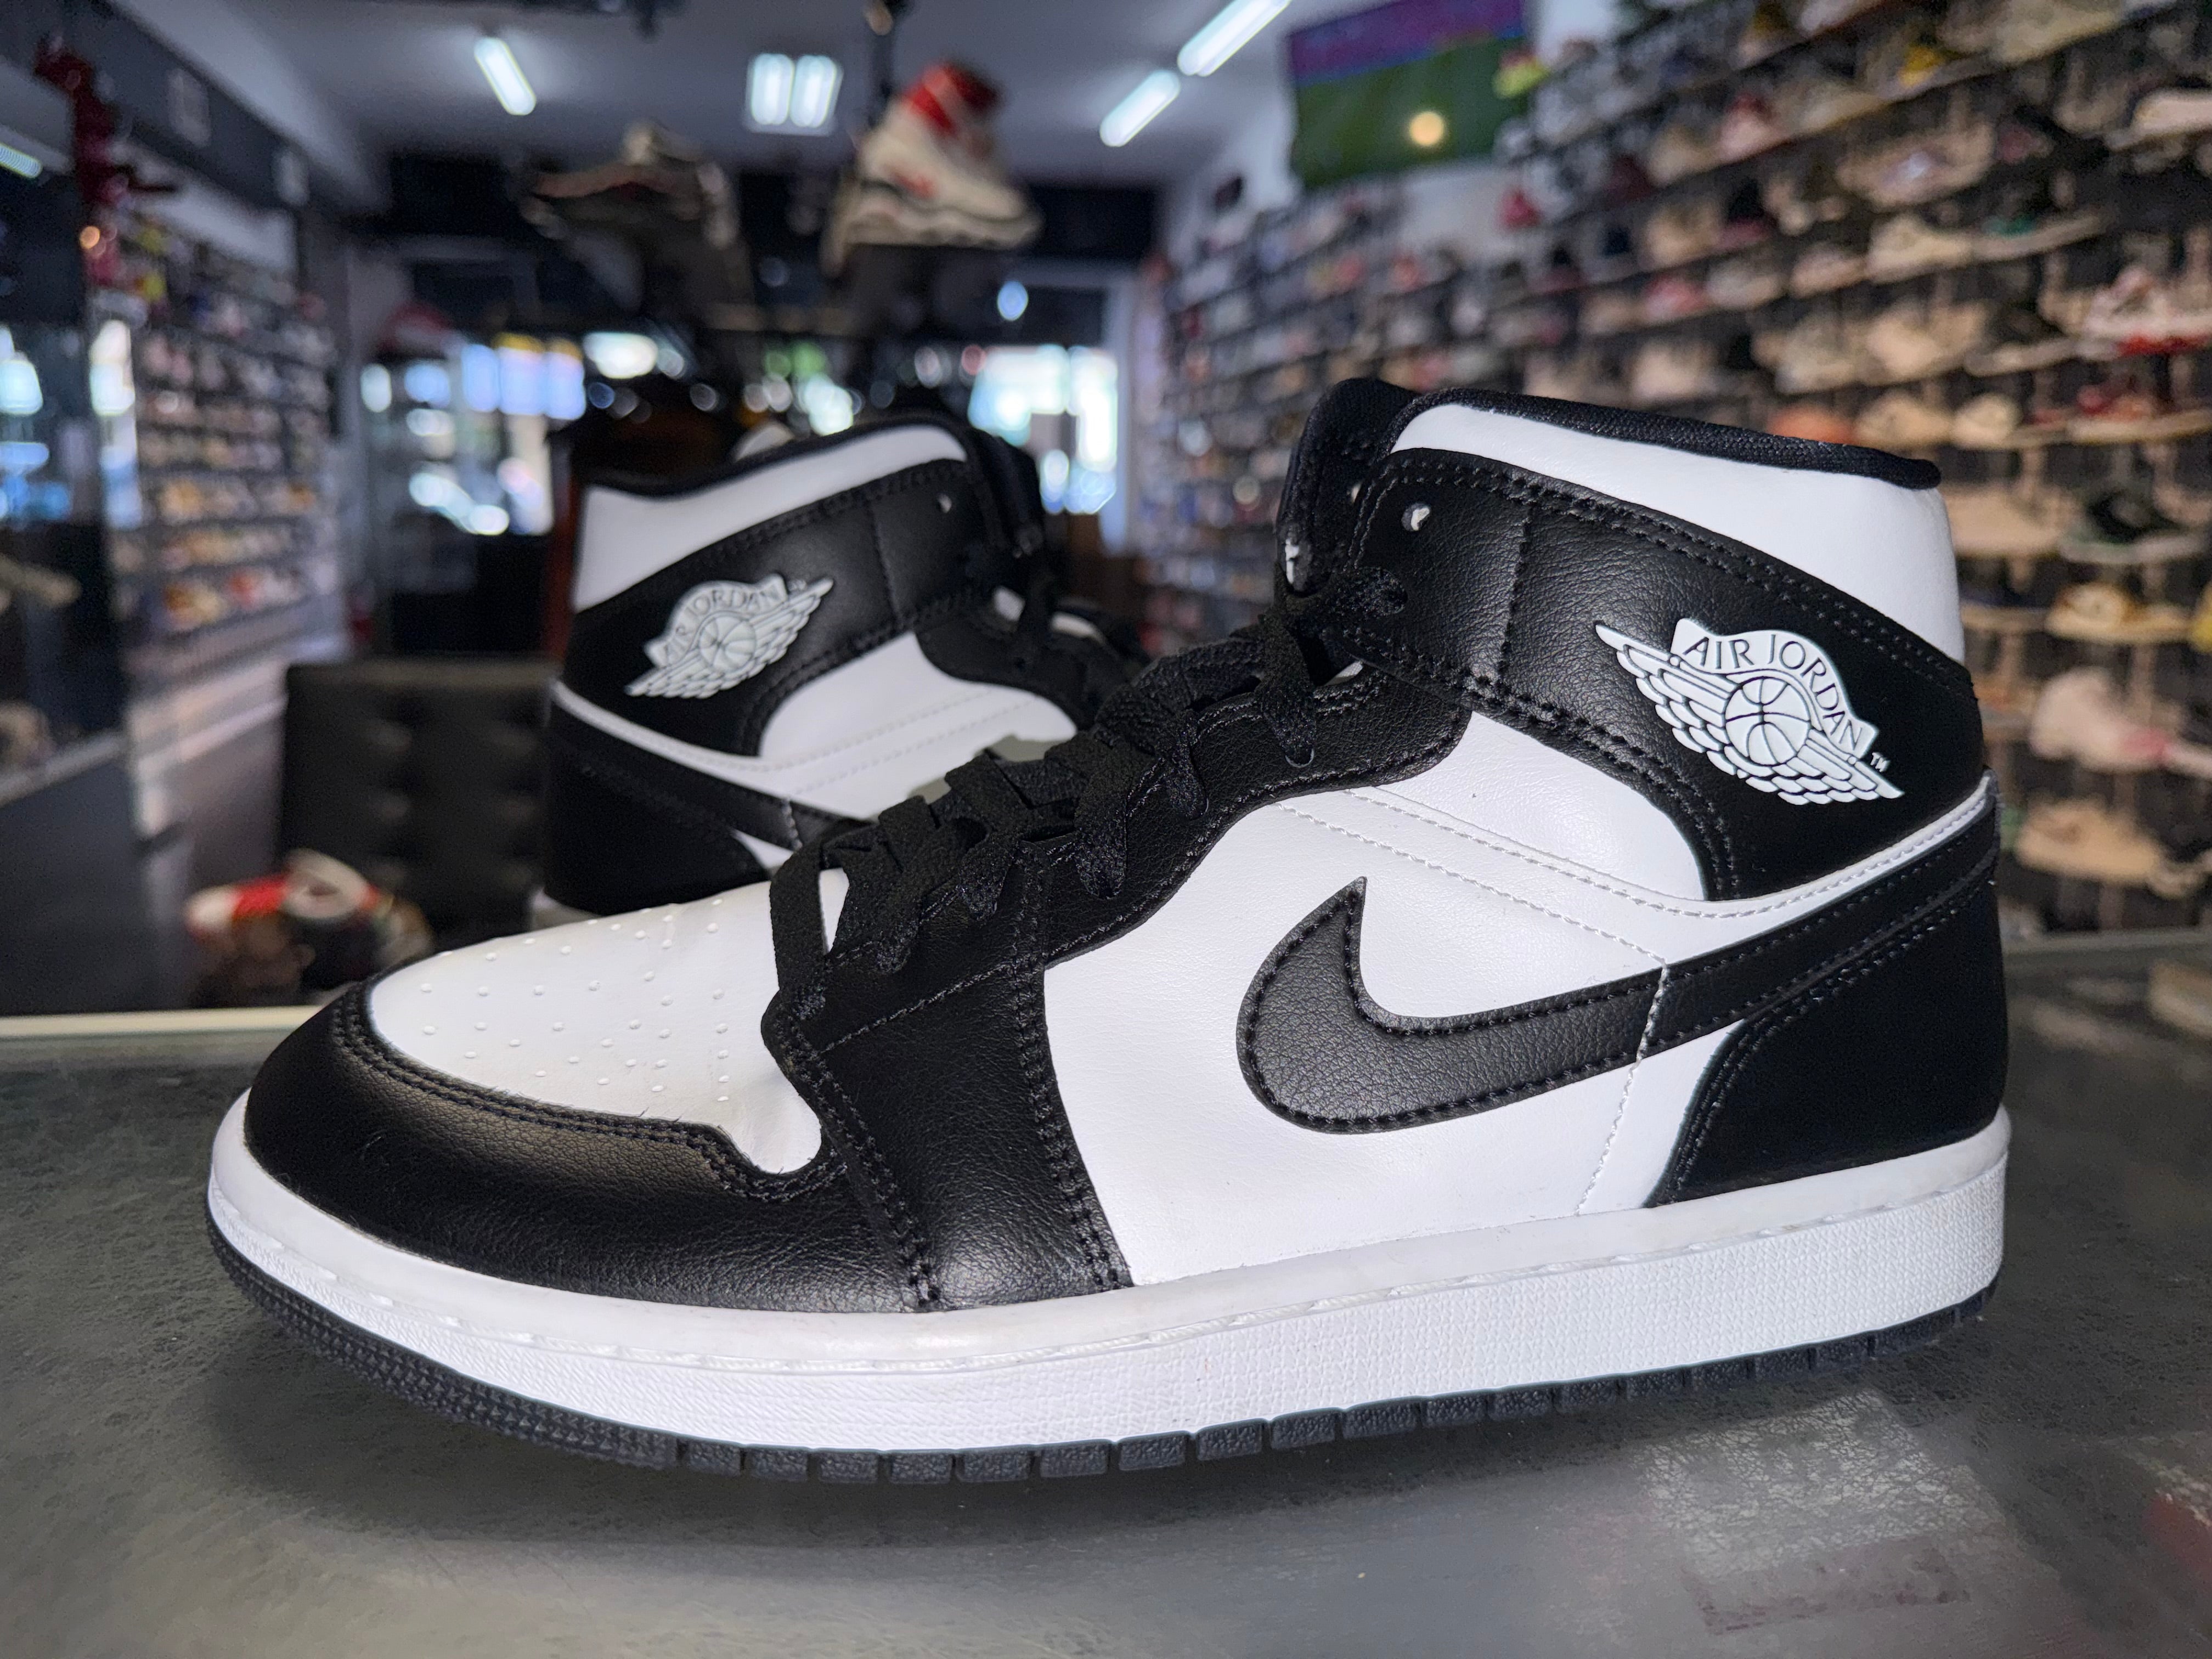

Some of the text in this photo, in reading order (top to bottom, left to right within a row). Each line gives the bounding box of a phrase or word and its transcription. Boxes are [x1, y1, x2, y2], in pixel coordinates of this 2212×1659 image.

[686, 583, 782, 617] JORDAN
[1682, 634, 1864, 751] AIR JORDAN
[1870, 752, 1891, 772] TM
